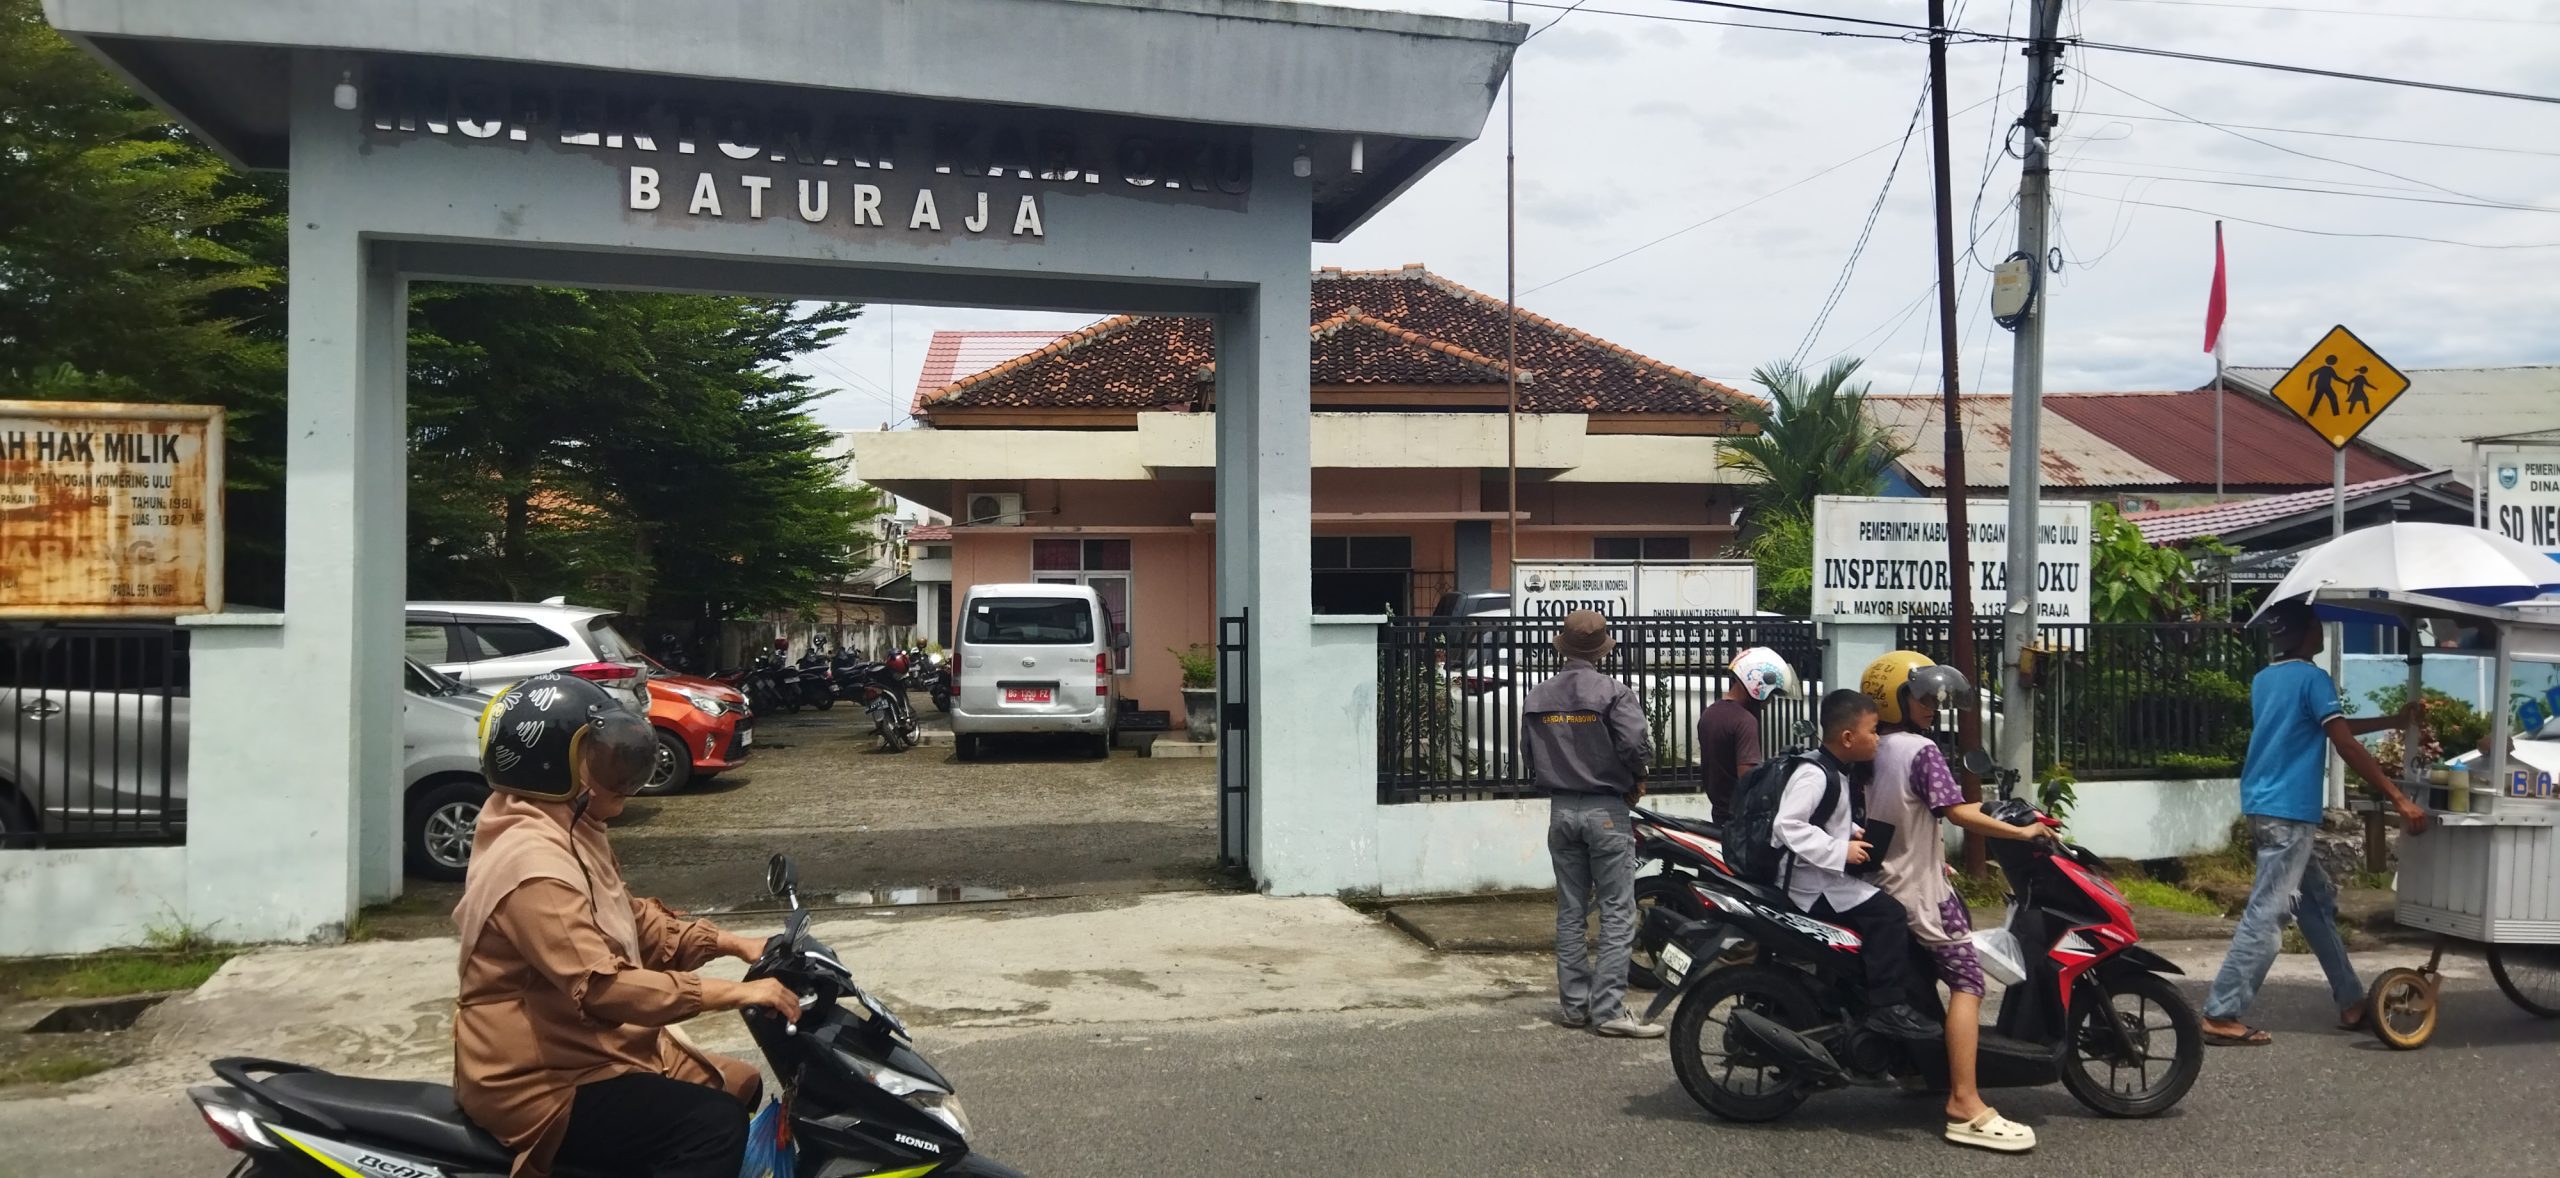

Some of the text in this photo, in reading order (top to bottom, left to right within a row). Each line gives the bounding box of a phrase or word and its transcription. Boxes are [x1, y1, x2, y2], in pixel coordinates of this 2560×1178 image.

[630, 166, 1044, 237] BATURAJA
[37, 431, 95, 463] HAK
[104, 433, 180, 464] MILIK
[63, 474, 93, 487] OGAN
[96, 474, 149, 488] KOMERING
[152, 475, 172, 489] ULU
[169, 498, 192, 509] 1981
[158, 514, 184, 526] 1327
[2500, 504, 2560, 546] SD NE
[1860, 521, 1920, 541] PEMERINTAH
[1980, 523, 2006, 543] OGAN
[2060, 525, 2078, 545] ULU
[1824, 558, 1975, 591] INSPEKTOR
[2037, 561, 2079, 592] OKU
[1582, 580, 1604, 591] REPUBLIK
[1604, 580, 1628, 591] INDONESIA
[1834, 601, 1850, 615] JL.
[1854, 601, 1894, 616] MAYOR
[895, 1133, 940, 1153] HONDA
